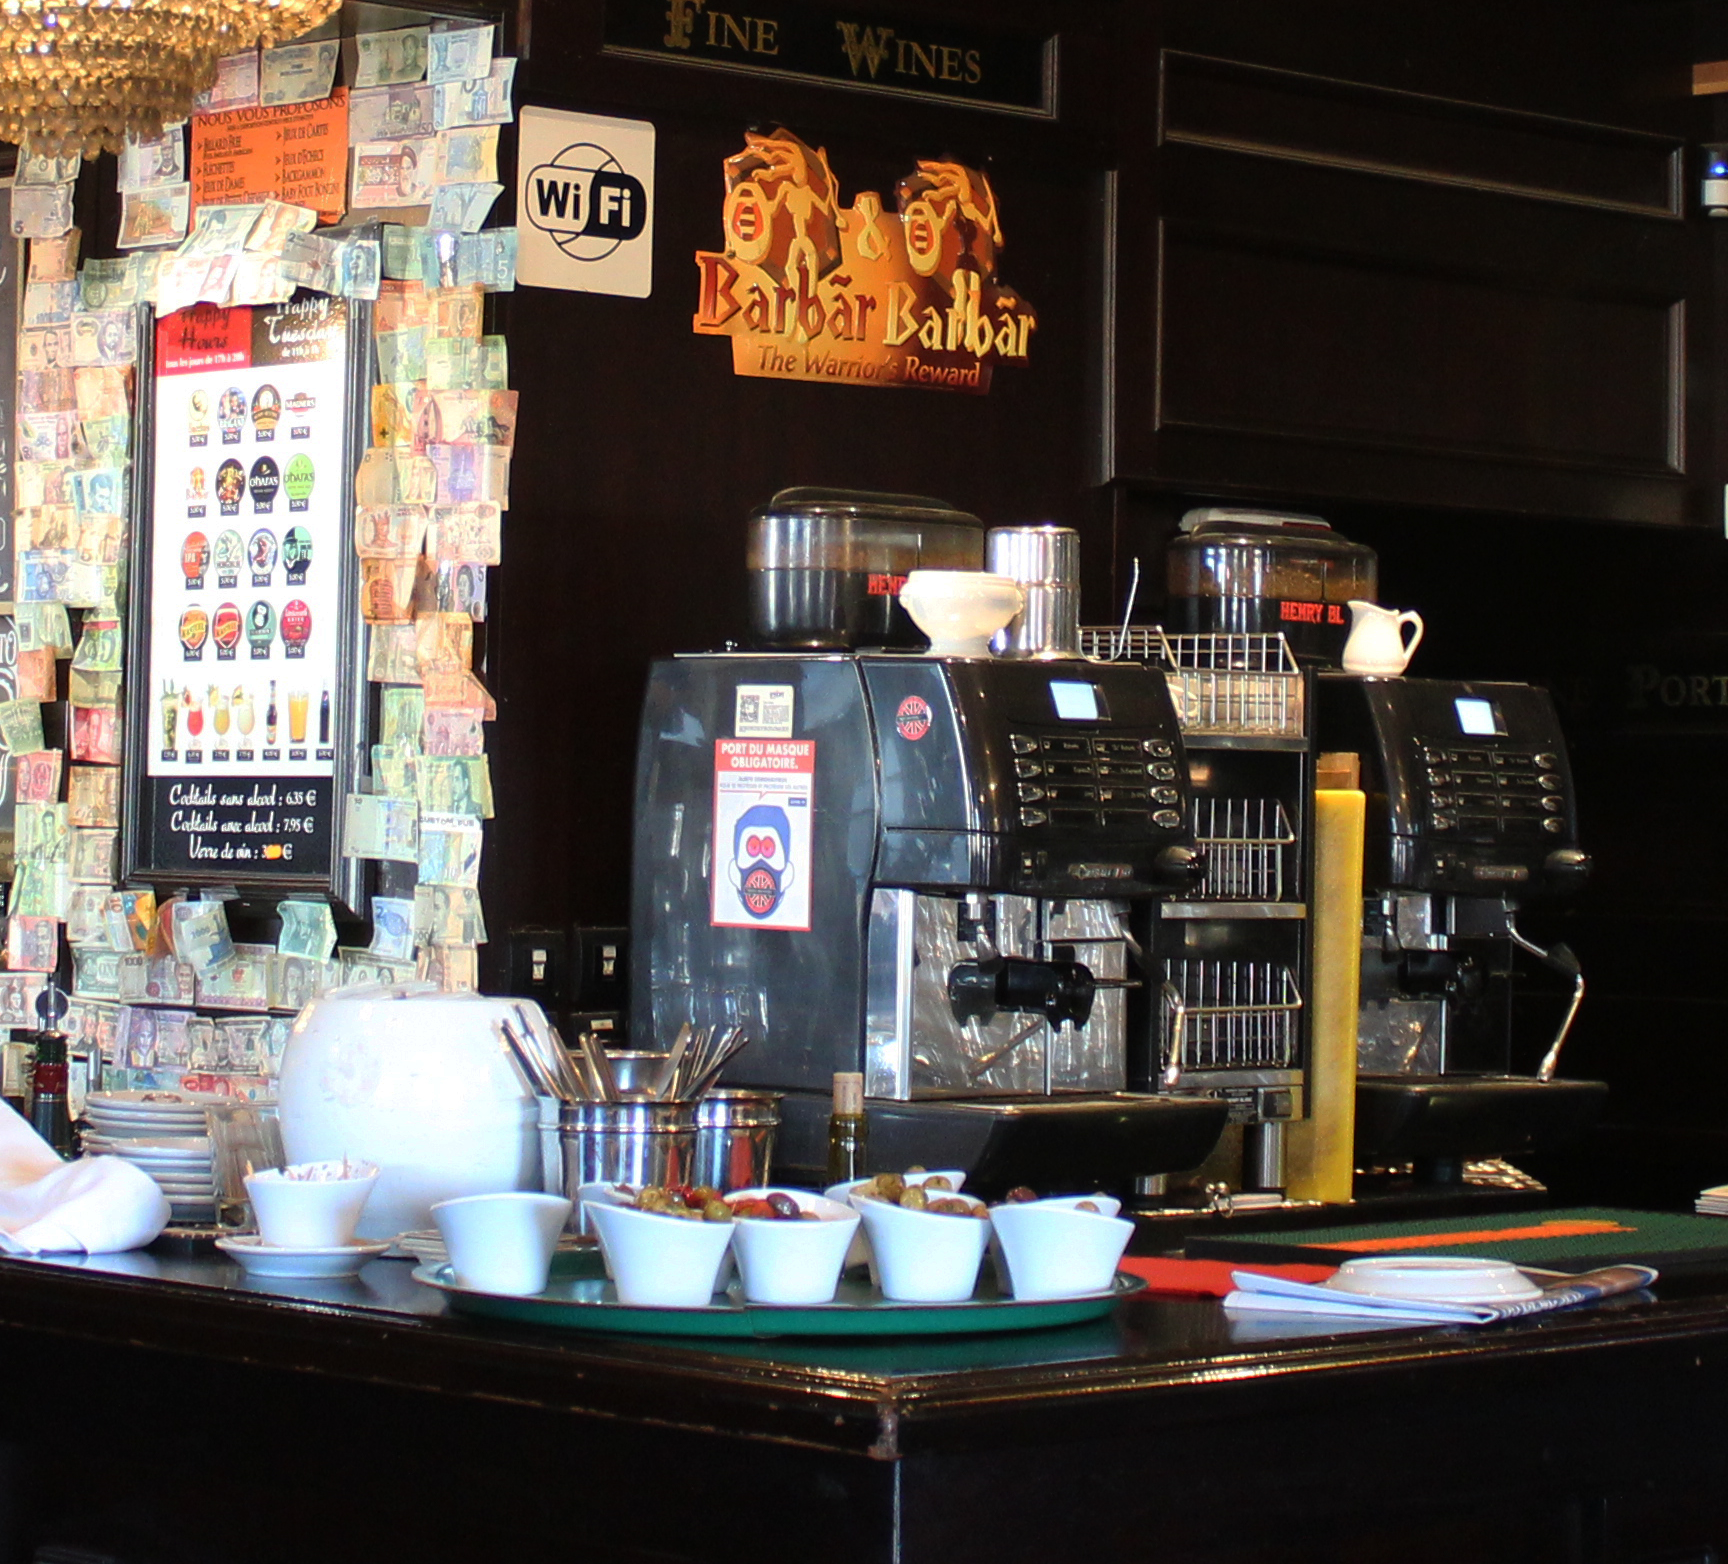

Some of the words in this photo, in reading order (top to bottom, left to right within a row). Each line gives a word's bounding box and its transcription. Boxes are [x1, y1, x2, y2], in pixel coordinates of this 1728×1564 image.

[198, 111, 232, 128] NOUS
[236, 107, 269, 123] VOUS
[497, 259, 508, 279] 5
[757, 345, 797, 374] The
[804, 350, 898, 381] Warrior's
[904, 355, 981, 387] Reward
[721, 743, 747, 756] PORT
[749, 743, 764, 756] DU
[766, 743, 810, 757] MASQUE
[730, 756, 799, 770] OBLIGATOIRE.
[220, 794, 244, 806] sans
